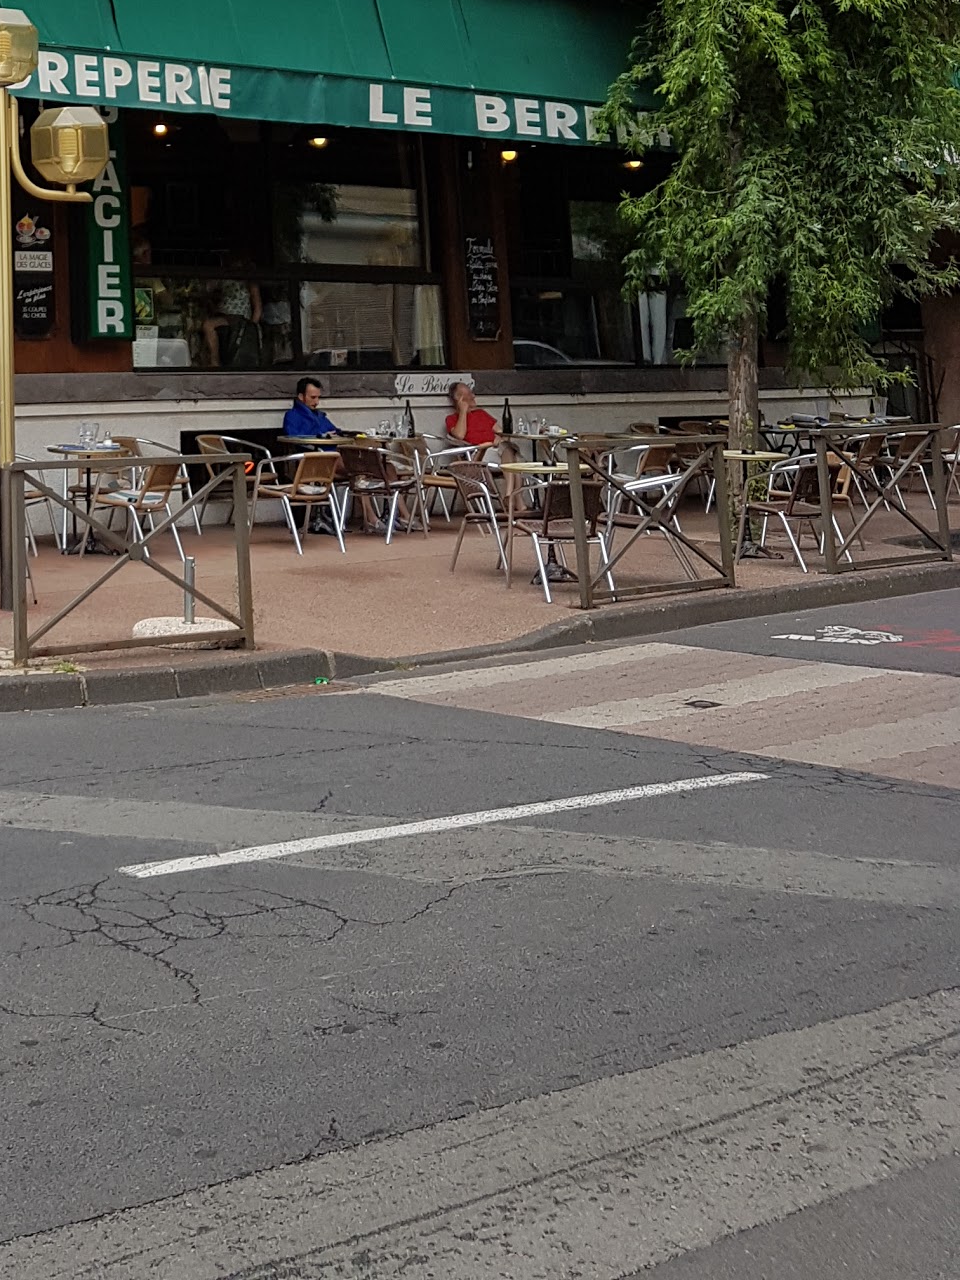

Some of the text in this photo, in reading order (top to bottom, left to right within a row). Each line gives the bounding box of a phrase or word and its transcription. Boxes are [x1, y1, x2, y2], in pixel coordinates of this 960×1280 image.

[6, 50, 231, 109] REPERIE
[369, 84, 433, 126] LE
[92, 105, 125, 334] ACIER
[399, 375, 415, 393] Le
